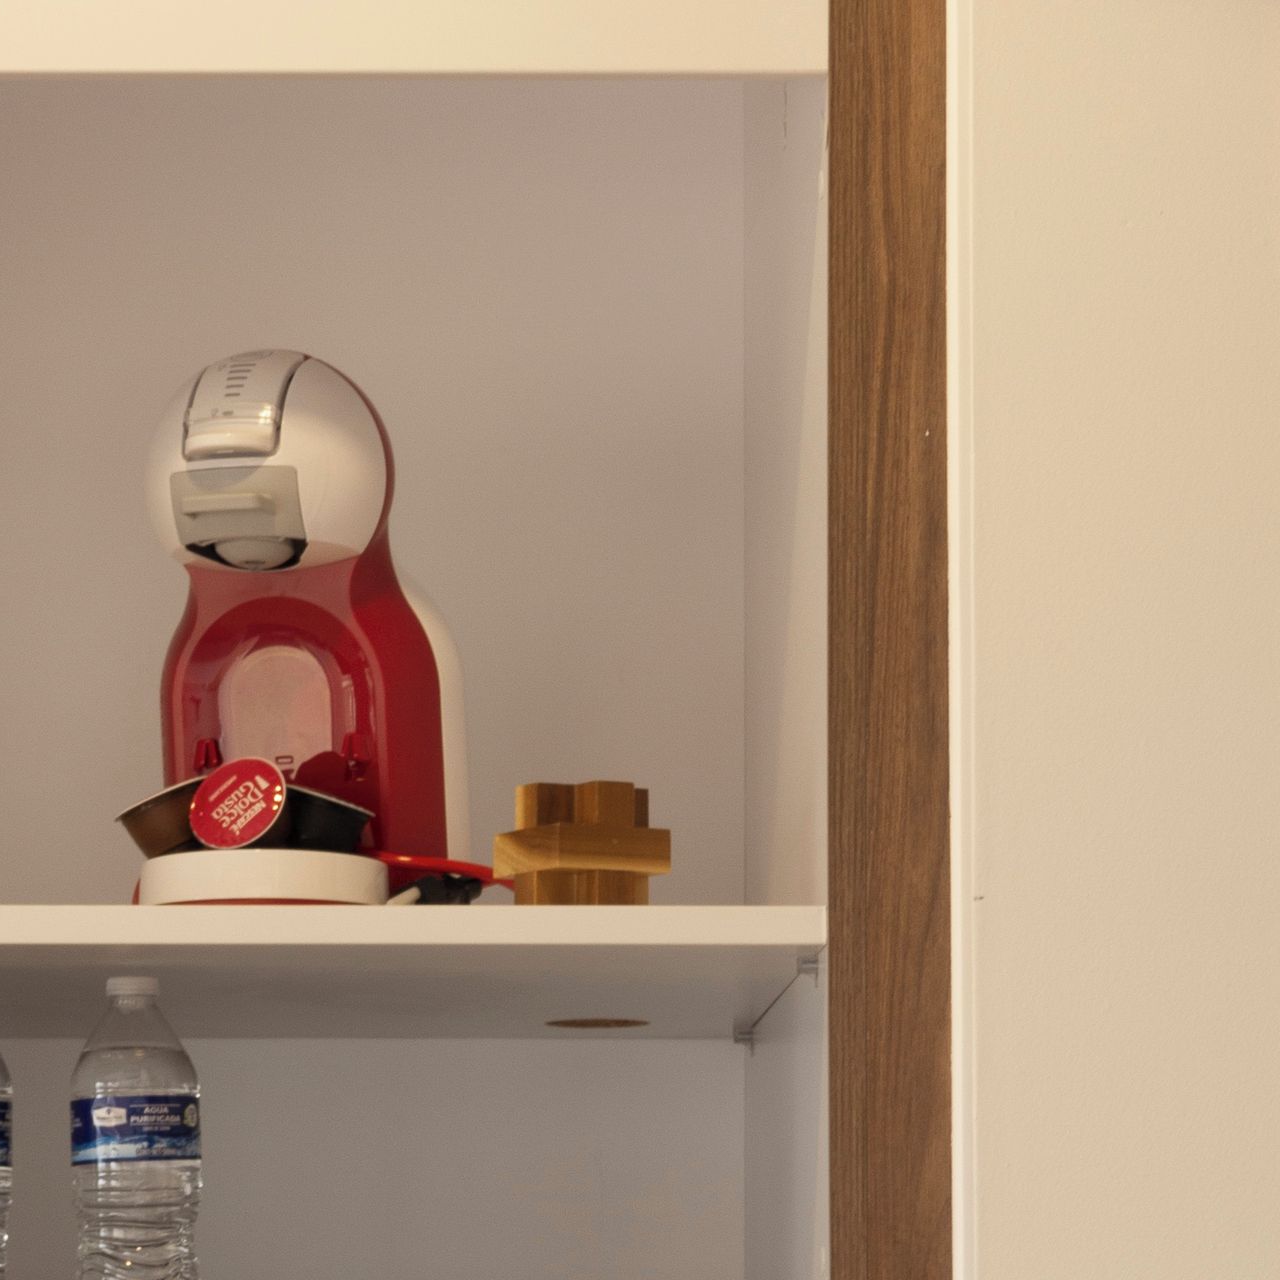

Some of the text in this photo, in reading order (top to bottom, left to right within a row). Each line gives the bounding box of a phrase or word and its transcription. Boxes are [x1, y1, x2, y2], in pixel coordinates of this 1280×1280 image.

[218, 787, 264, 828] Dolce
[143, 1106, 169, 1114] AGUA
[129, 1115, 181, 1123] PURIFICADA
